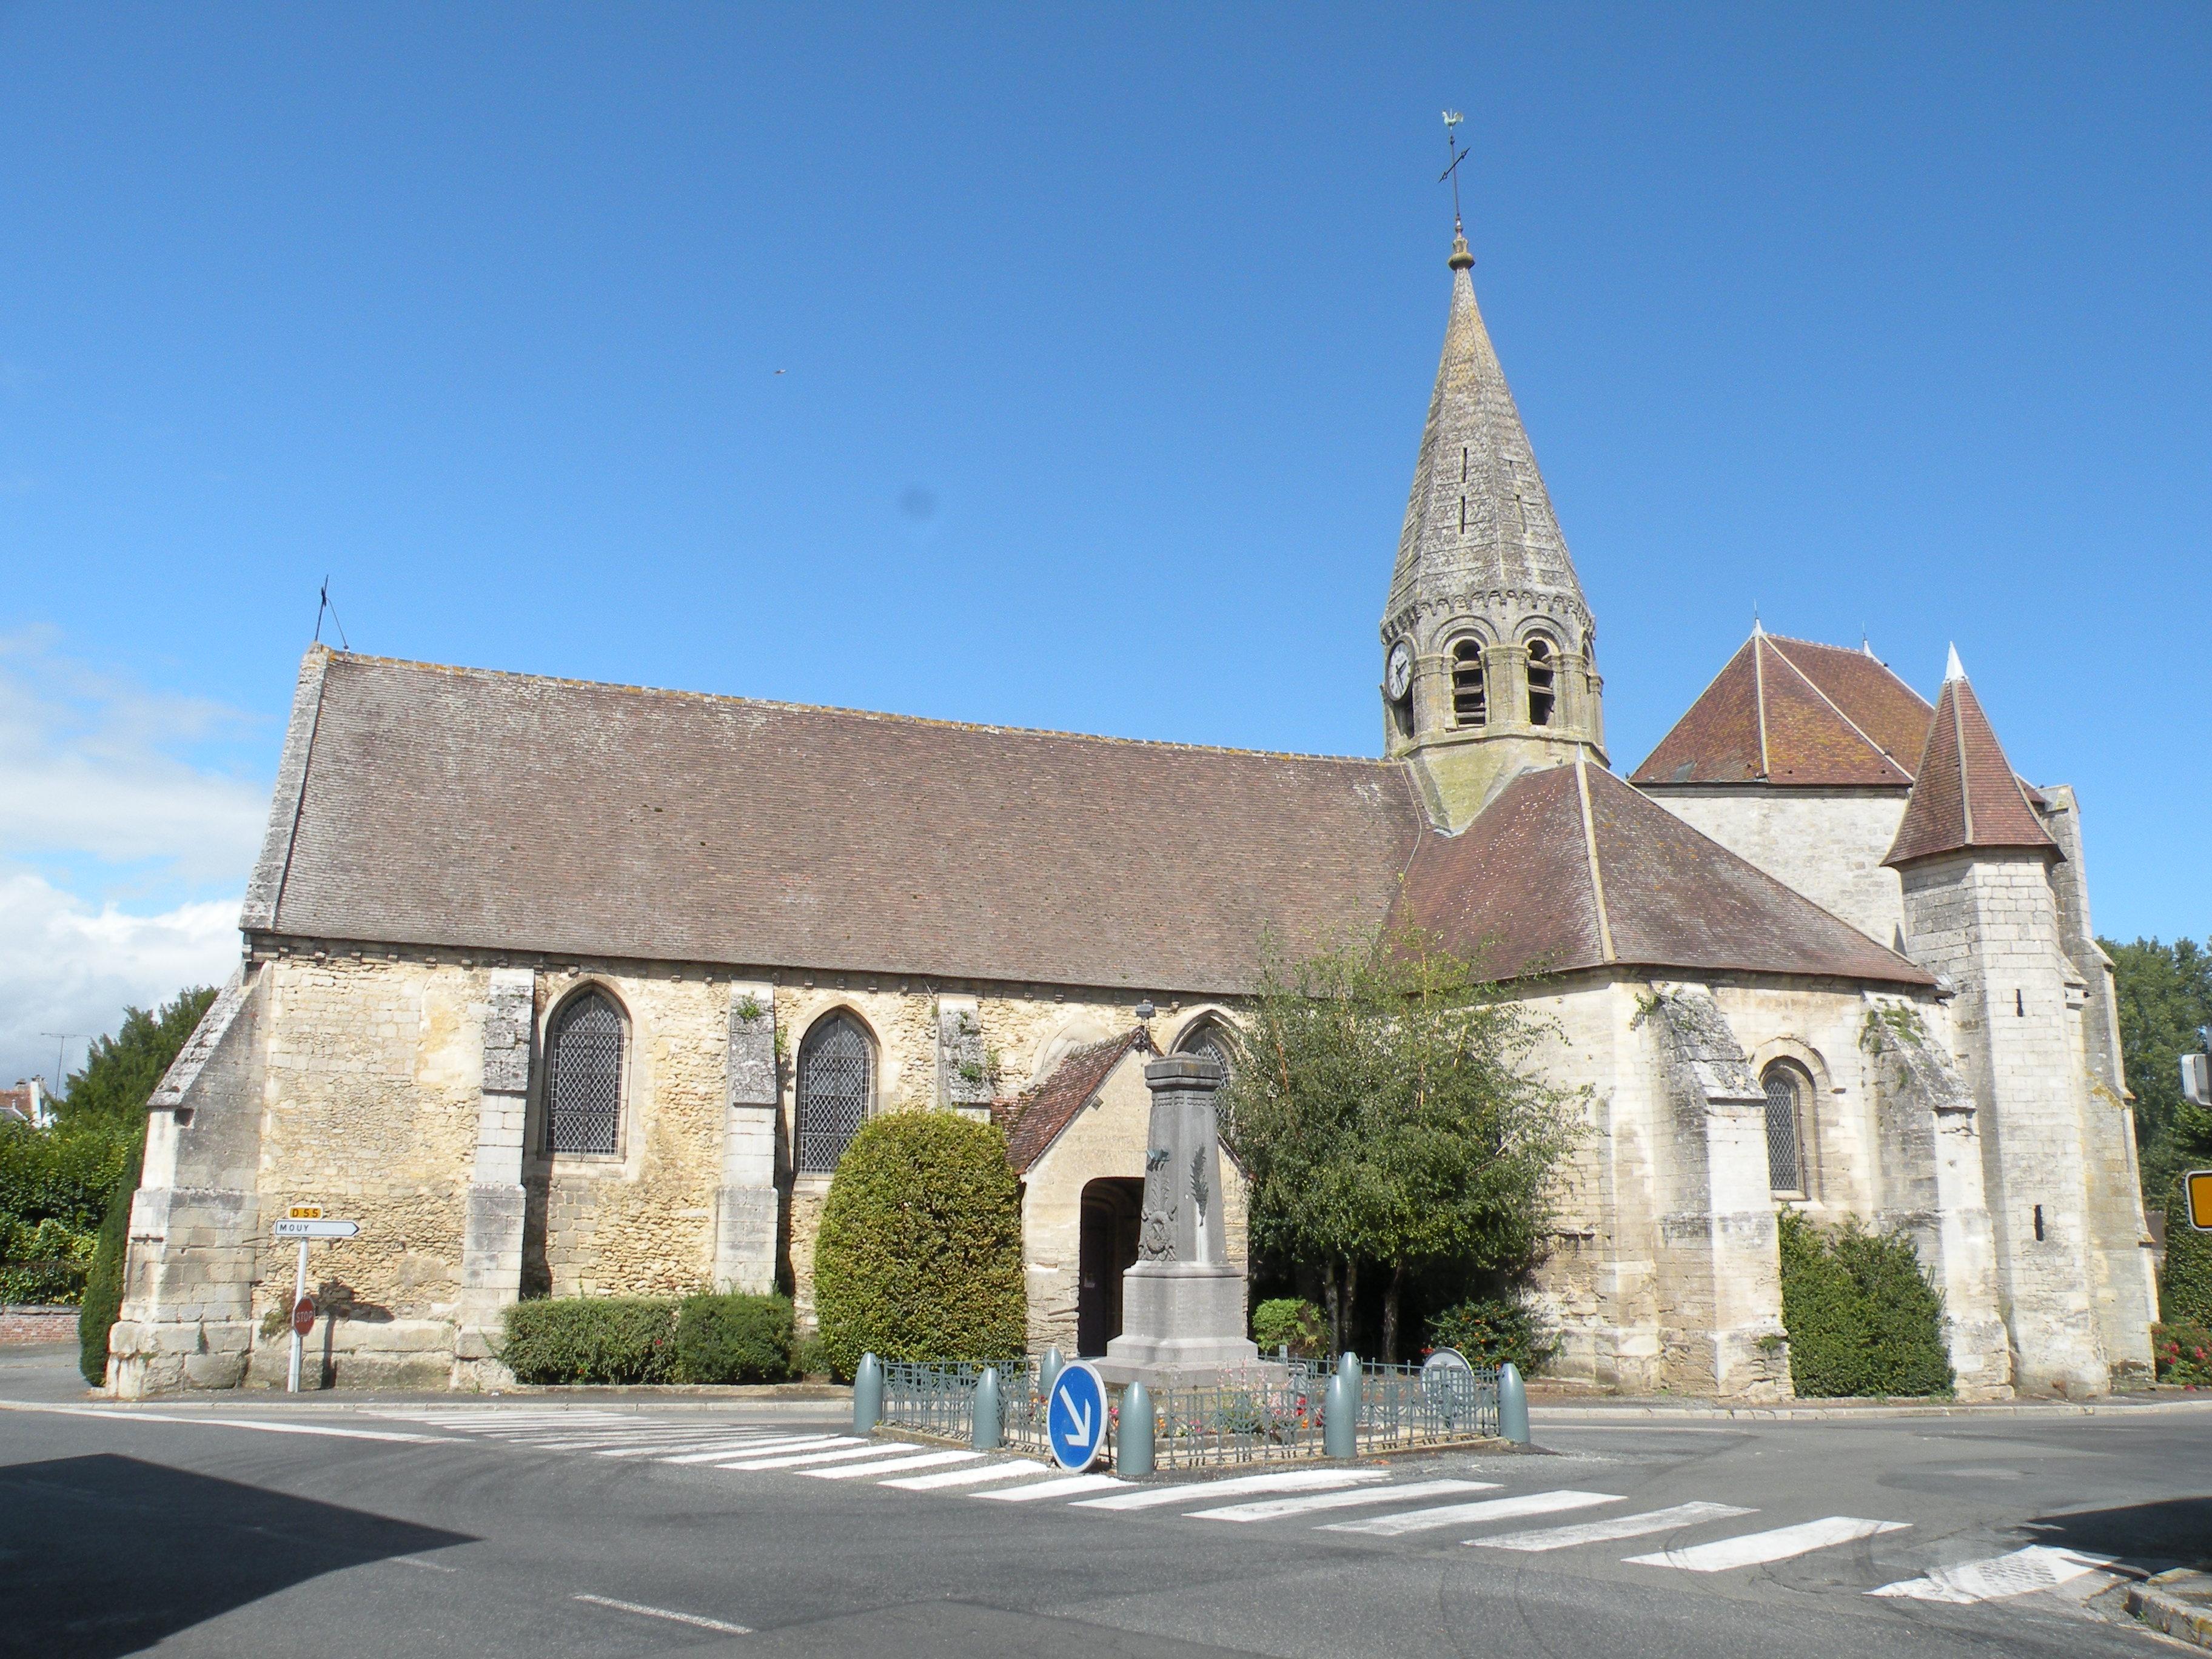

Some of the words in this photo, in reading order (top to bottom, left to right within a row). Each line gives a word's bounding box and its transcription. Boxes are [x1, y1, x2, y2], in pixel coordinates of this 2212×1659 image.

[292, 1208, 299, 1218] D
[304, 1208, 318, 1218] 55
[296, 1310, 313, 1323] STOP
